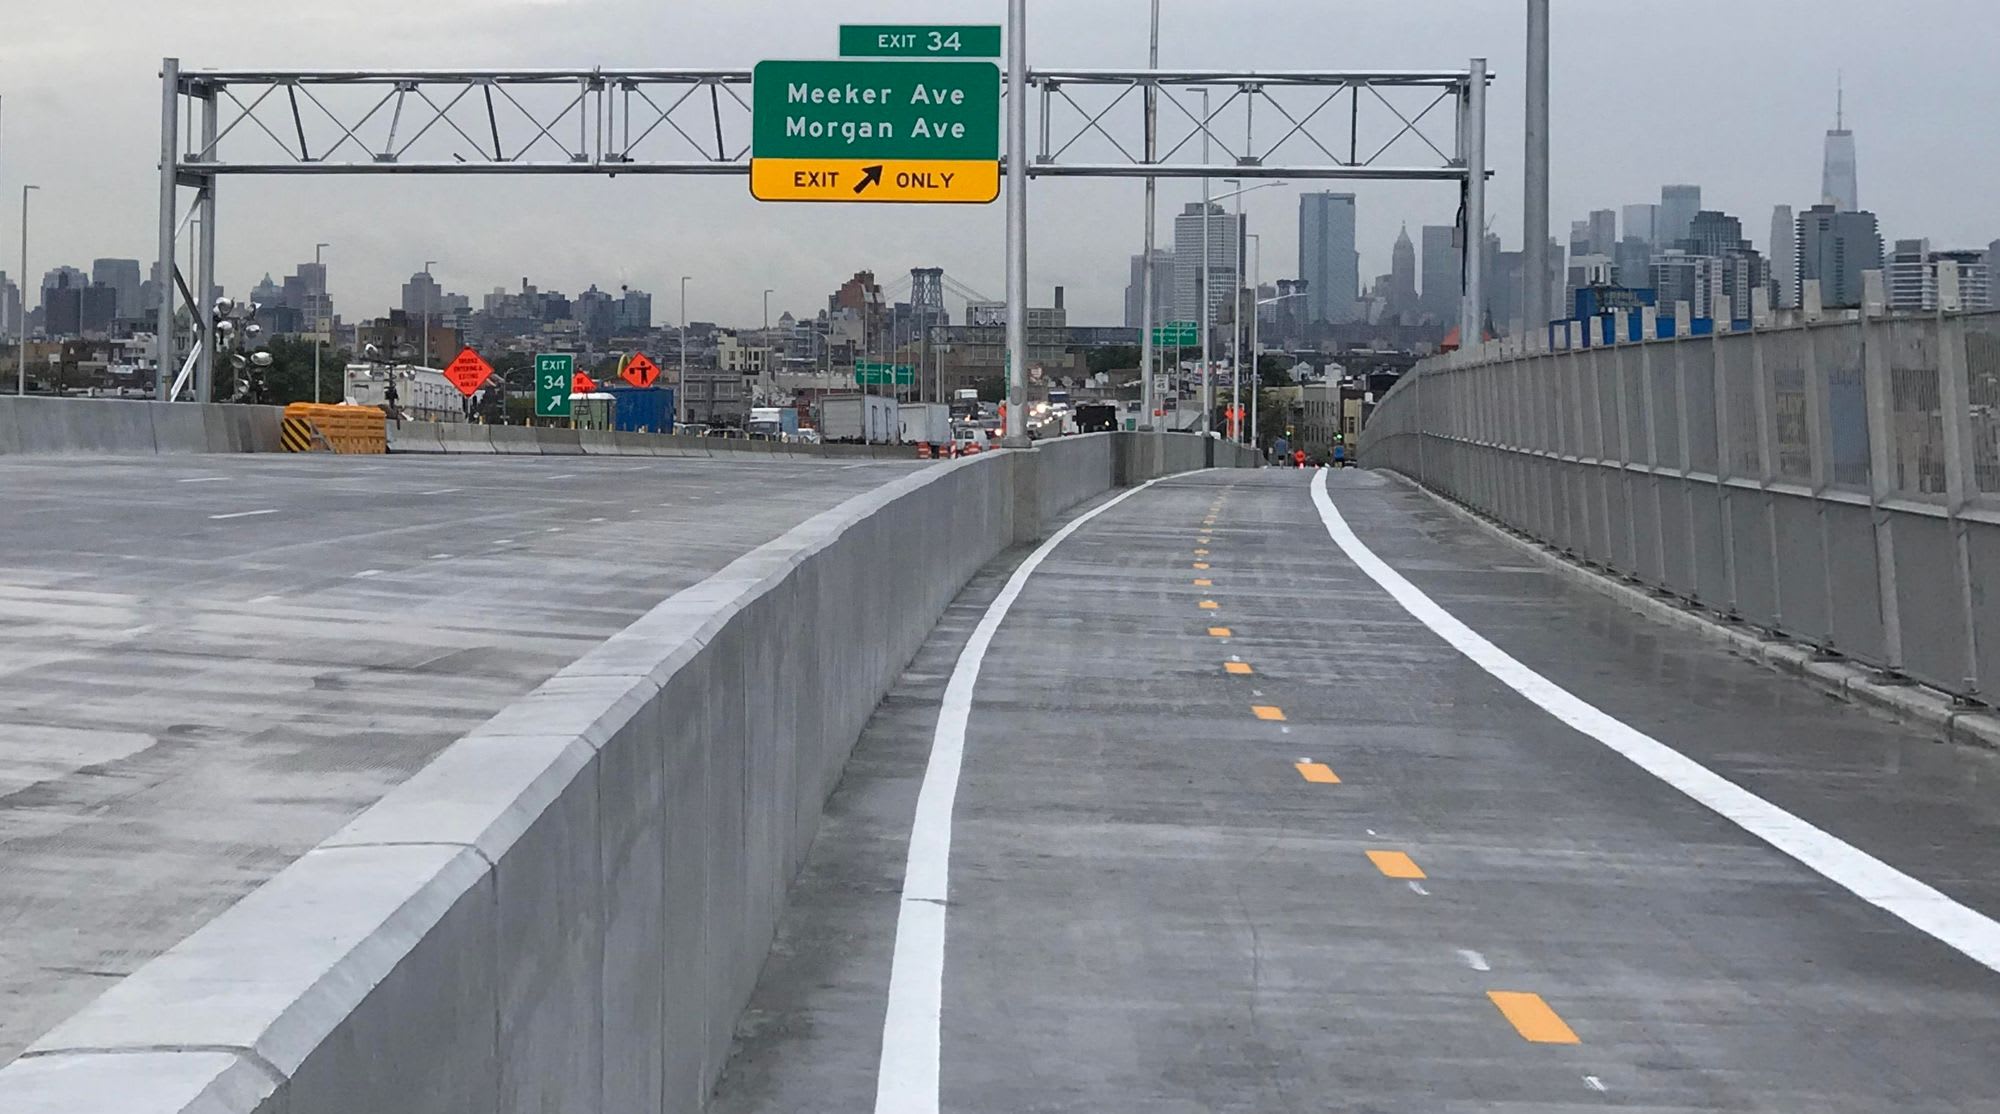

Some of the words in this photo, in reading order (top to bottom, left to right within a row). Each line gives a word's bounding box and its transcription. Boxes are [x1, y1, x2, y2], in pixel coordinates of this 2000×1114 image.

[878, 34, 917, 48] EXIT
[927, 31, 962, 51] 34
[788, 83, 892, 105] Meeker
[910, 84, 965, 105] Ave
[786, 116, 893, 144] Morgan
[910, 117, 966, 138] Ave
[794, 171, 840, 187] EXIT
[896, 172, 954, 188] ONLY
[542, 360, 566, 370] EXIT
[543, 375, 565, 390] 34
